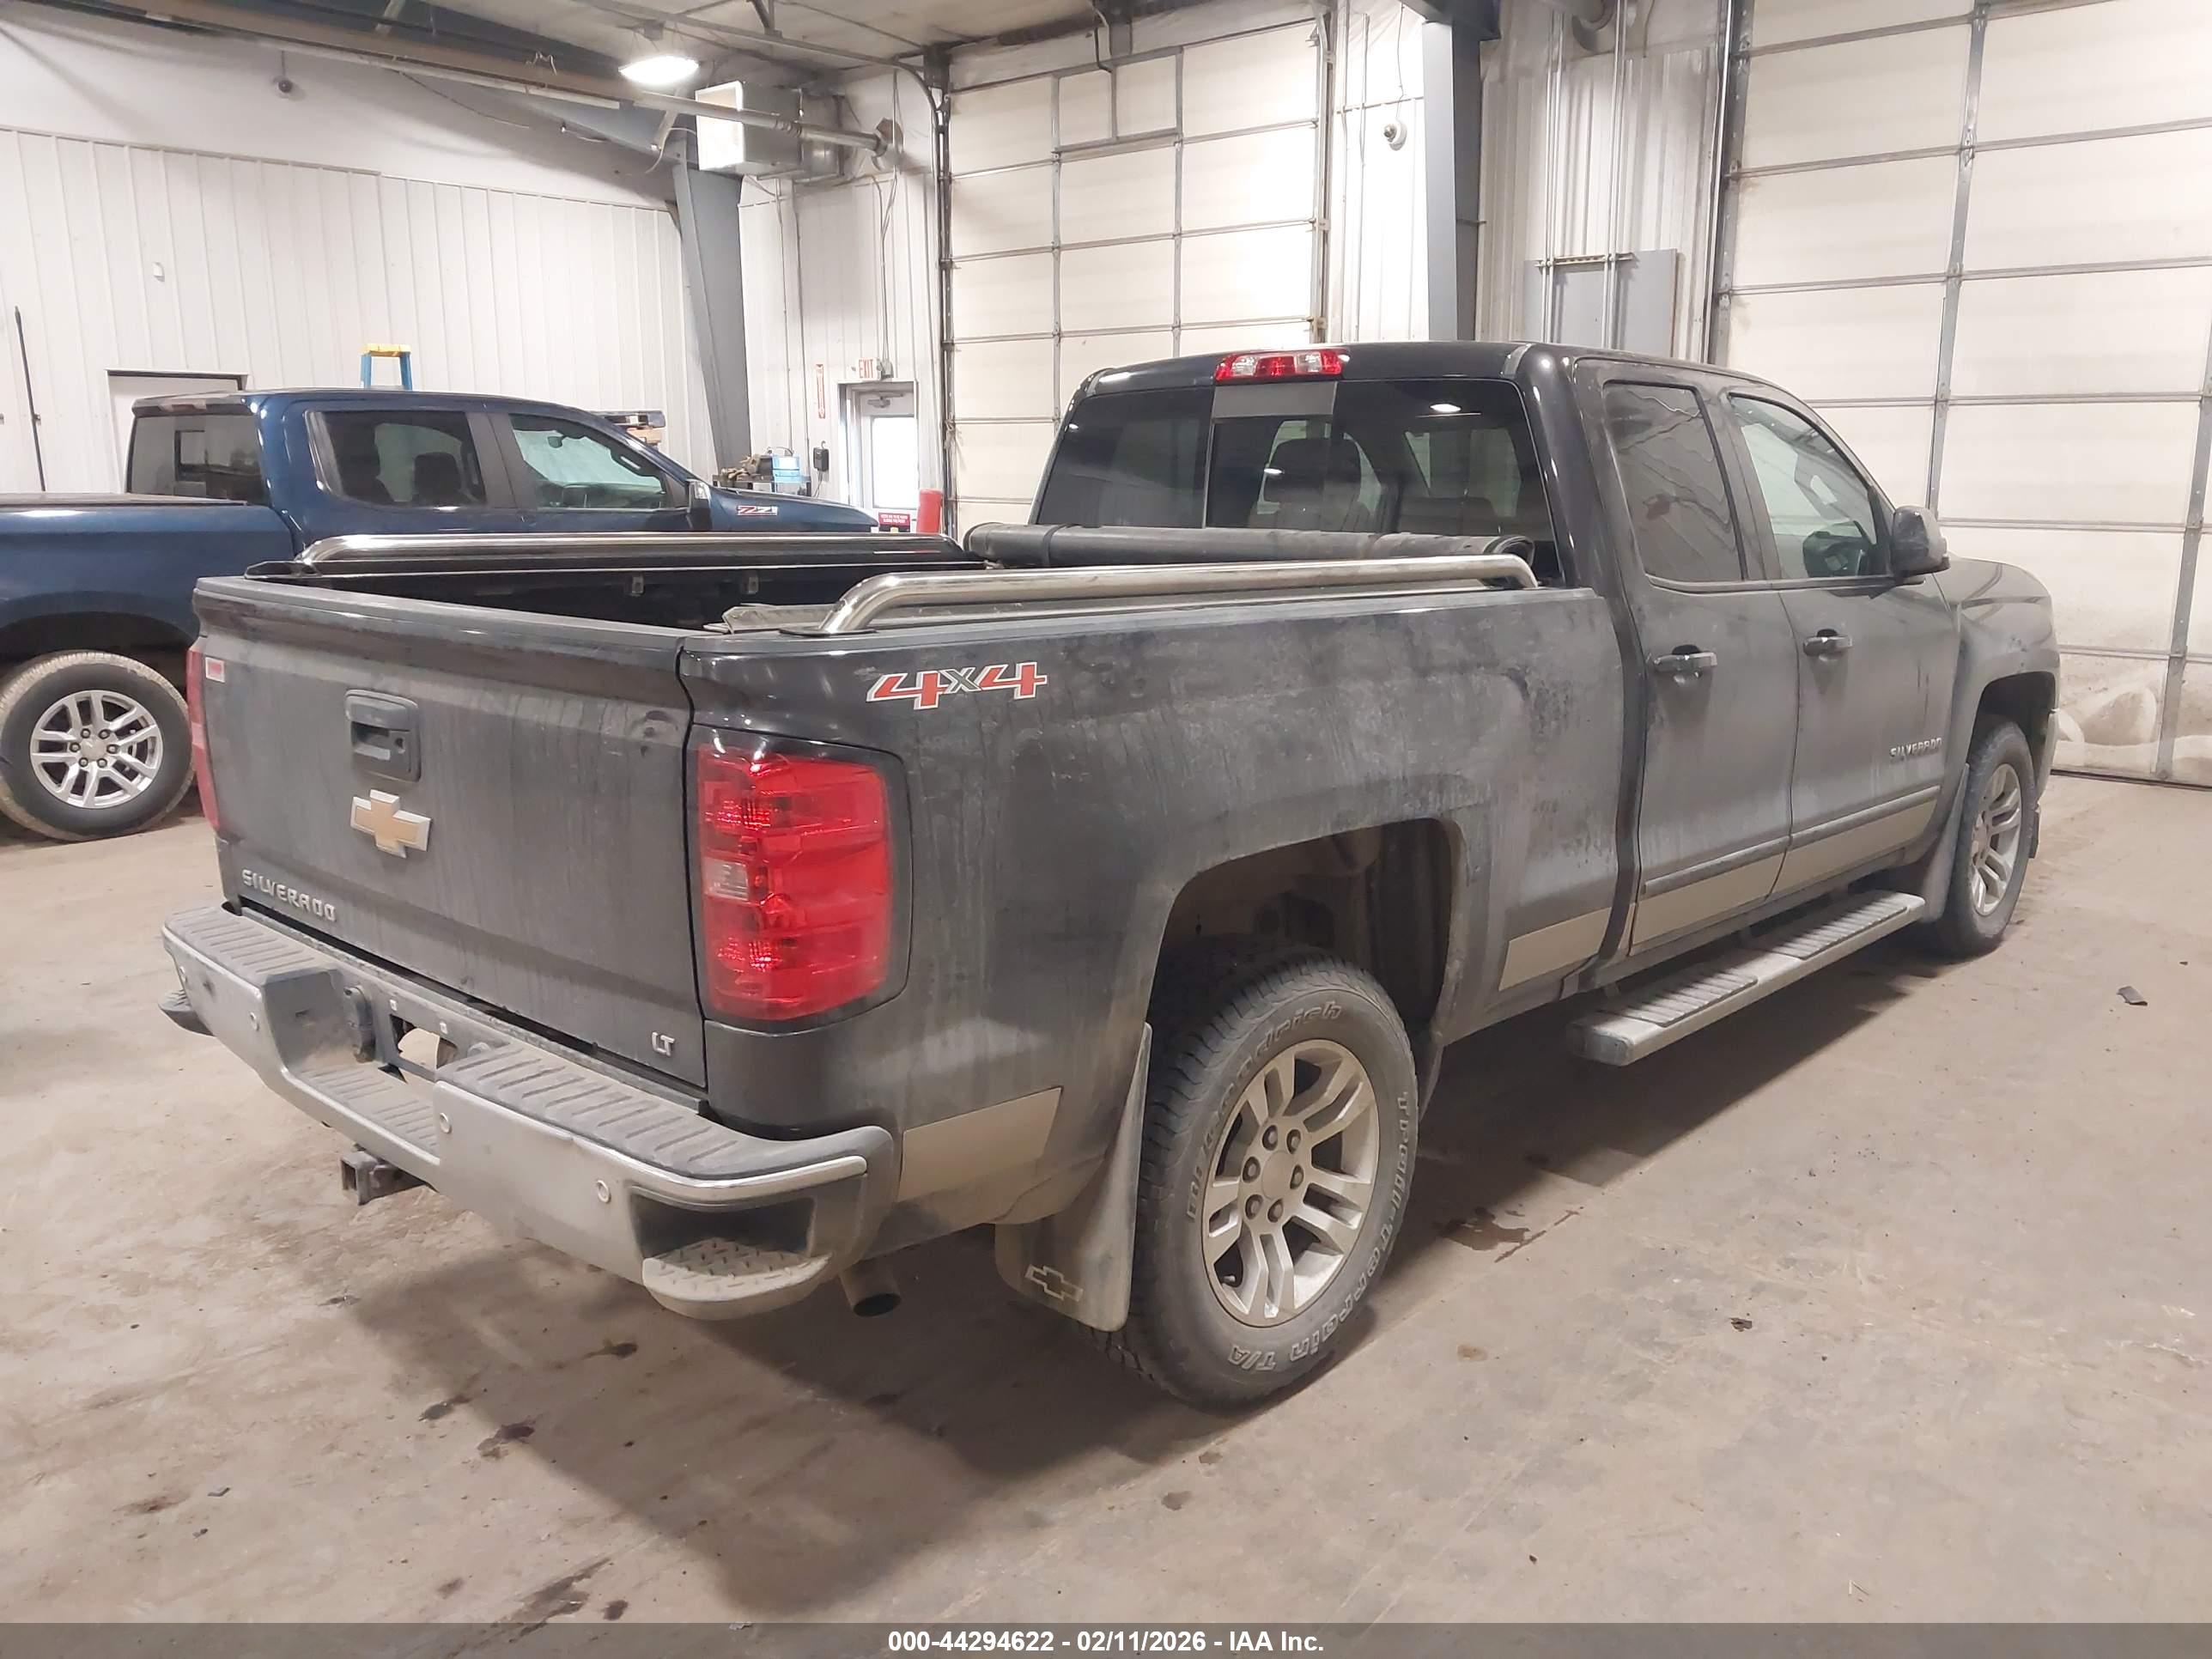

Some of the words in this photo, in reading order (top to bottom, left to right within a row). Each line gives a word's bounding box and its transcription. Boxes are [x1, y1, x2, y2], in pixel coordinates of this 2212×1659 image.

[858, 358, 873, 379] EXIT
[241, 868, 337, 922] SILVERADO
[652, 1031, 676, 1057] LT
